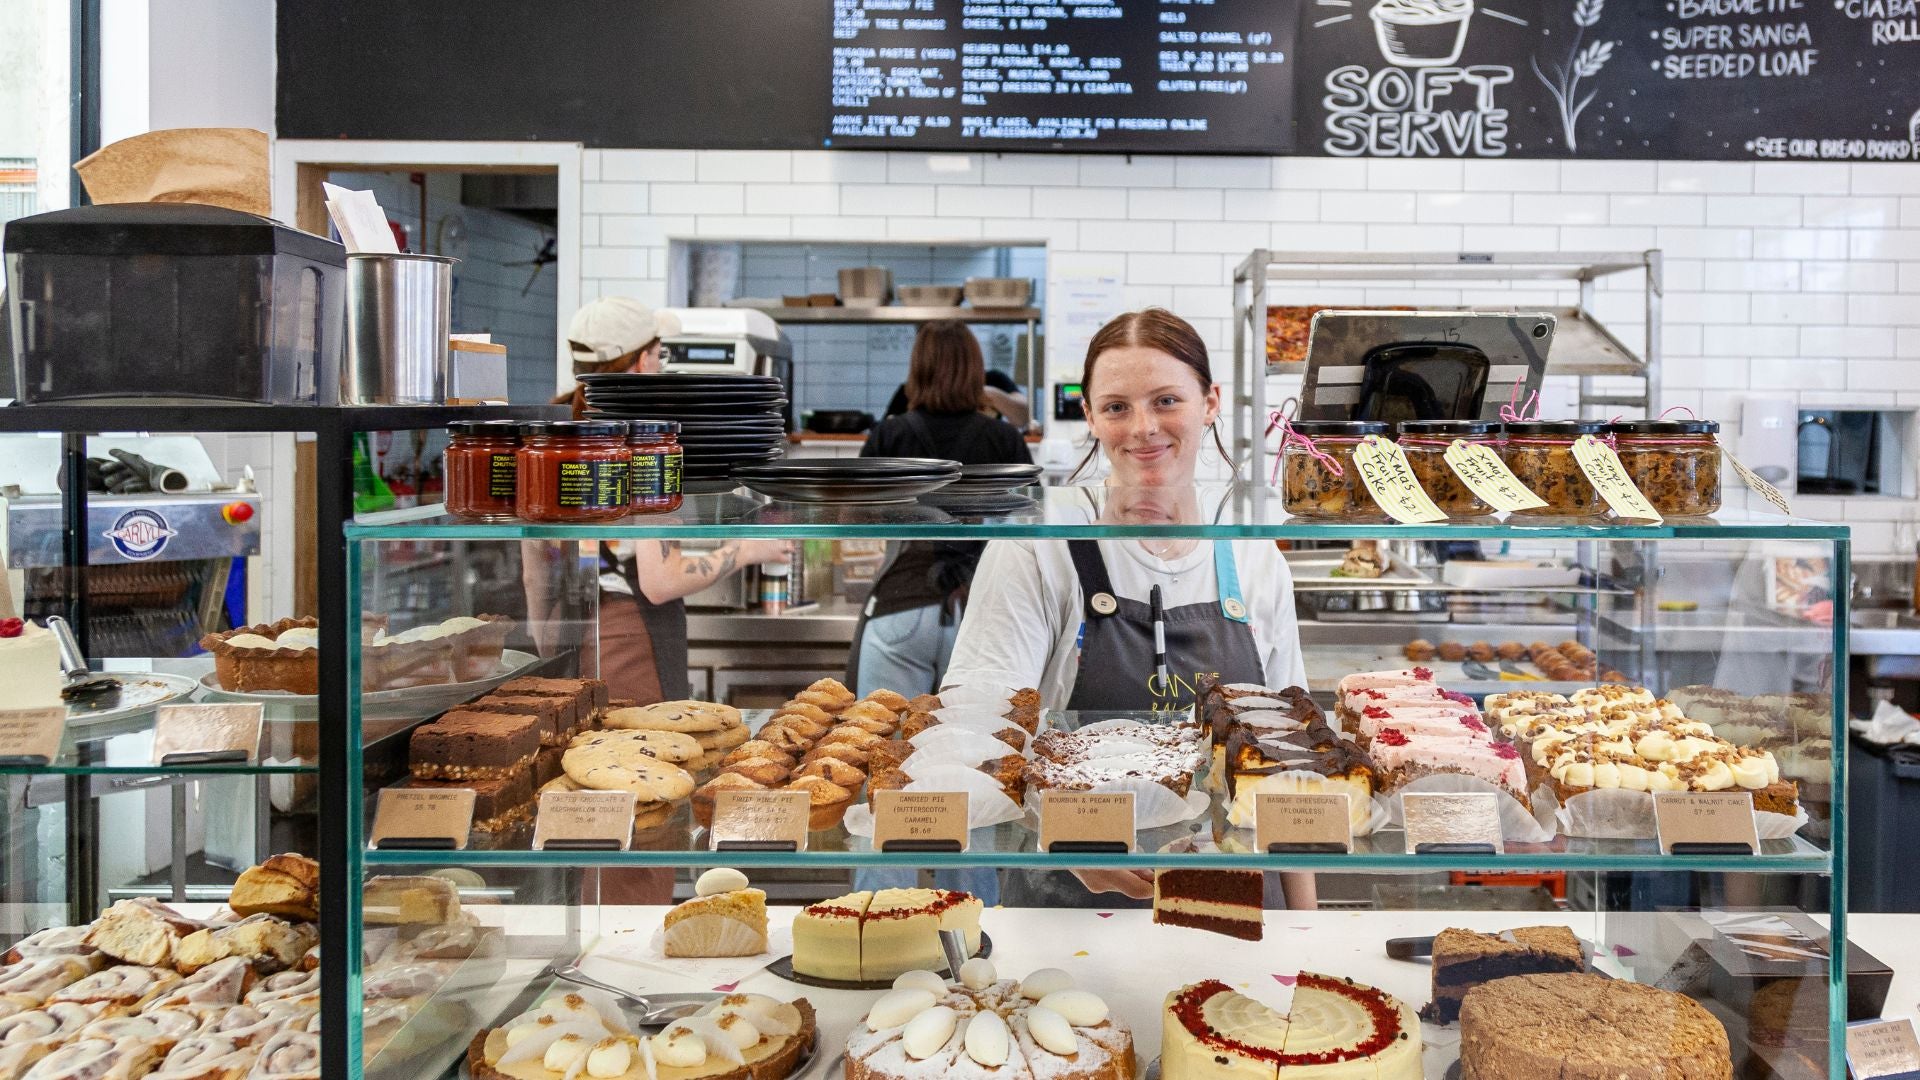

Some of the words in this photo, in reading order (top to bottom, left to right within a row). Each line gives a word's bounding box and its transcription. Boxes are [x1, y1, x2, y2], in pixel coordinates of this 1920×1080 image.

[1072, 6, 1123, 19] AMERICAN
[1159, 31, 1198, 43] SALTED
[1199, 31, 1243, 44] CARAMEL
[1661, 25, 1735, 51] SUPER
[1737, 21, 1812, 49] SANGA
[962, 56, 988, 67] BEEF
[1663, 53, 1756, 79] SEEDED
[1758, 49, 1820, 77] LOAF
[962, 81, 1000, 93] ISLAND
[1071, 82, 1082, 94] A
[1083, 82, 1133, 95] CIABATTA
[1322, 65, 1515, 115] SOFT
[868, 115, 900, 126] ITEMS
[902, 115, 922, 127] ARE
[925, 115, 952, 128] ALSO
[1094, 118, 1116, 131] FOR
[1169, 119, 1208, 131] ONLINE
[1323, 110, 1510, 157] SERVE
[1755, 136, 1788, 159] SEE
[1789, 138, 1819, 159] OUR
[1820, 138, 1866, 159] BREAD
[1866, 139, 1911, 161] BOARD
[1371, 451, 1399, 486] Fruit
[1455, 461, 1482, 488] Cake
[1465, 456, 1495, 484] Fruit
[1362, 462, 1389, 496] Cake
[1584, 463, 1610, 492] Cake
[899, 796, 930, 804] CANDIED
[932, 796, 946, 804] PIE
[1048, 796, 1079, 804] BOURBON
[1089, 797, 1111, 805] PECAN
[1113, 797, 1128, 805] PIE
[1267, 797, 1292, 805] BASQUE
[1295, 797, 1337, 805] CHEESECAKE
[1660, 797, 1686, 805] CARROT
[1698, 798, 1724, 806] WALNUT
[1281, 807, 1326, 816] (FLOURLESS)
[904, 815, 937, 825] CARAMEL)
[909, 827, 932, 835] $8.60
